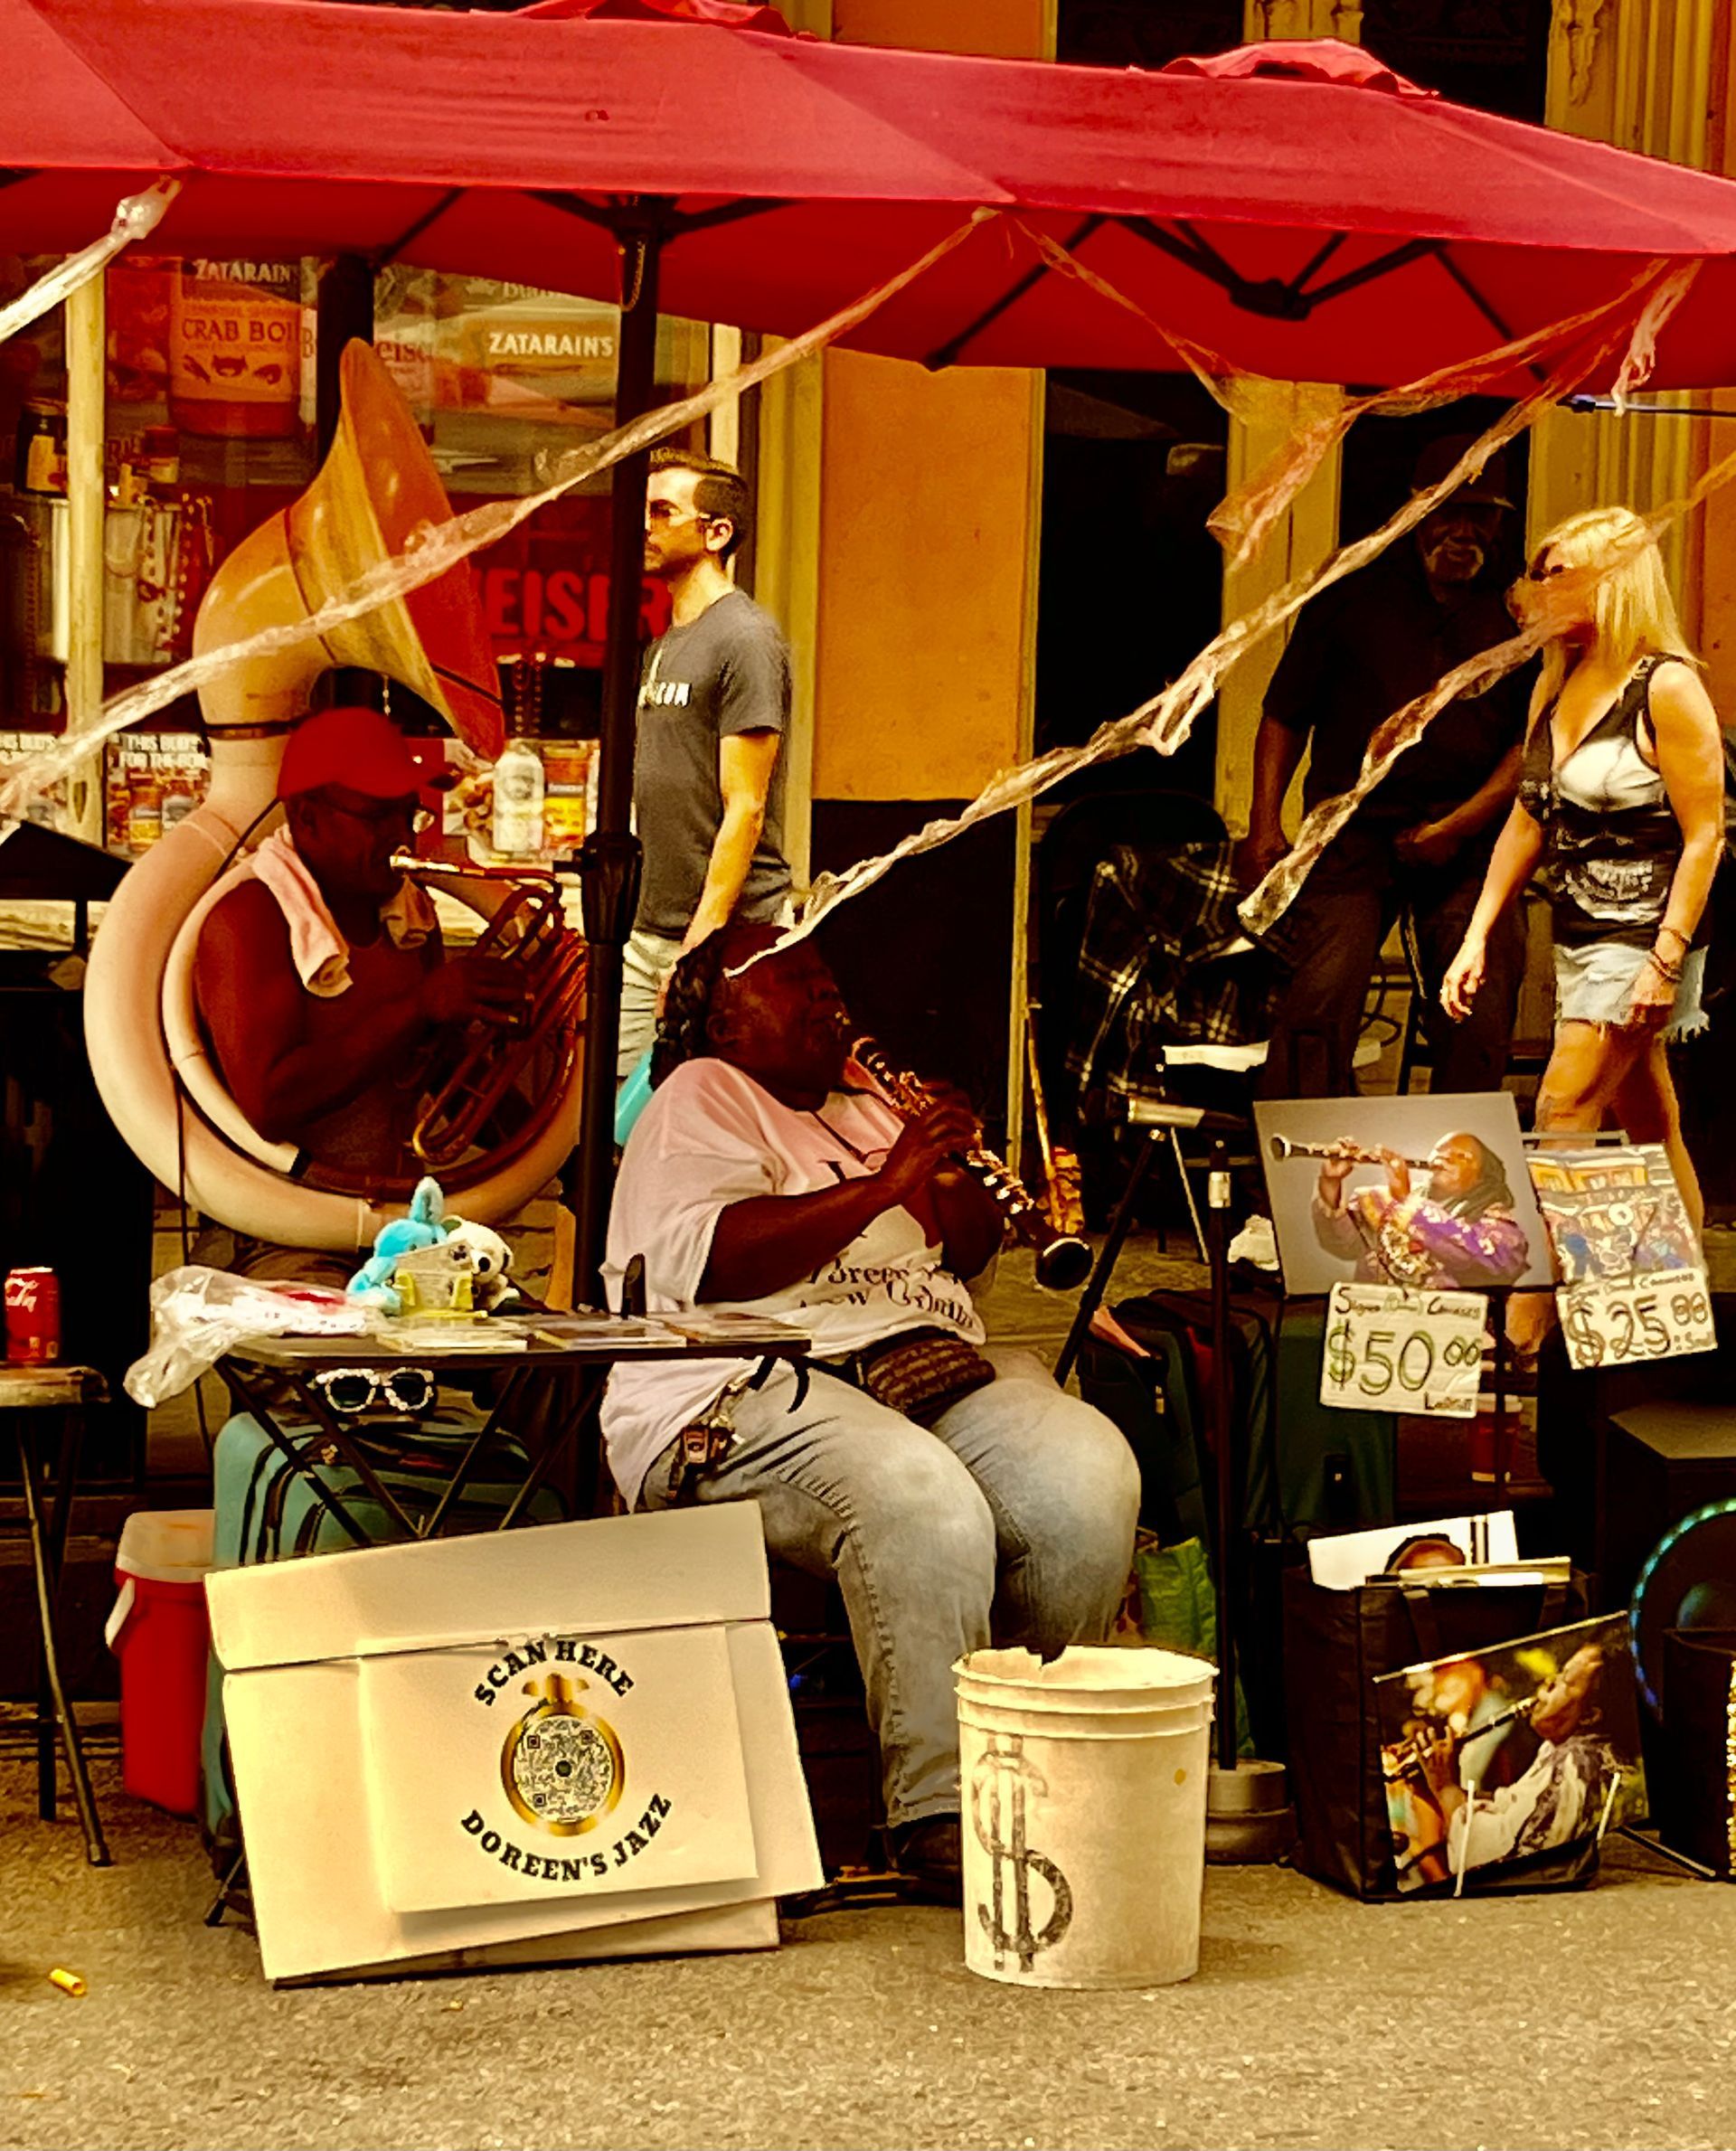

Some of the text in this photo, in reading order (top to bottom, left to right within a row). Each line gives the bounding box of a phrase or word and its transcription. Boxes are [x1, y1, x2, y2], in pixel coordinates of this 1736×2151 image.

[182, 317, 239, 343] CRAB
[488, 331, 614, 358] ZATARAIN'S
[1328, 1317, 1436, 1396] $50
[1567, 1294, 1671, 1368] $25
[474, 1640, 635, 1706] SCAN HERE
[460, 1793, 673, 1882] DOREEN'S JAZZ
